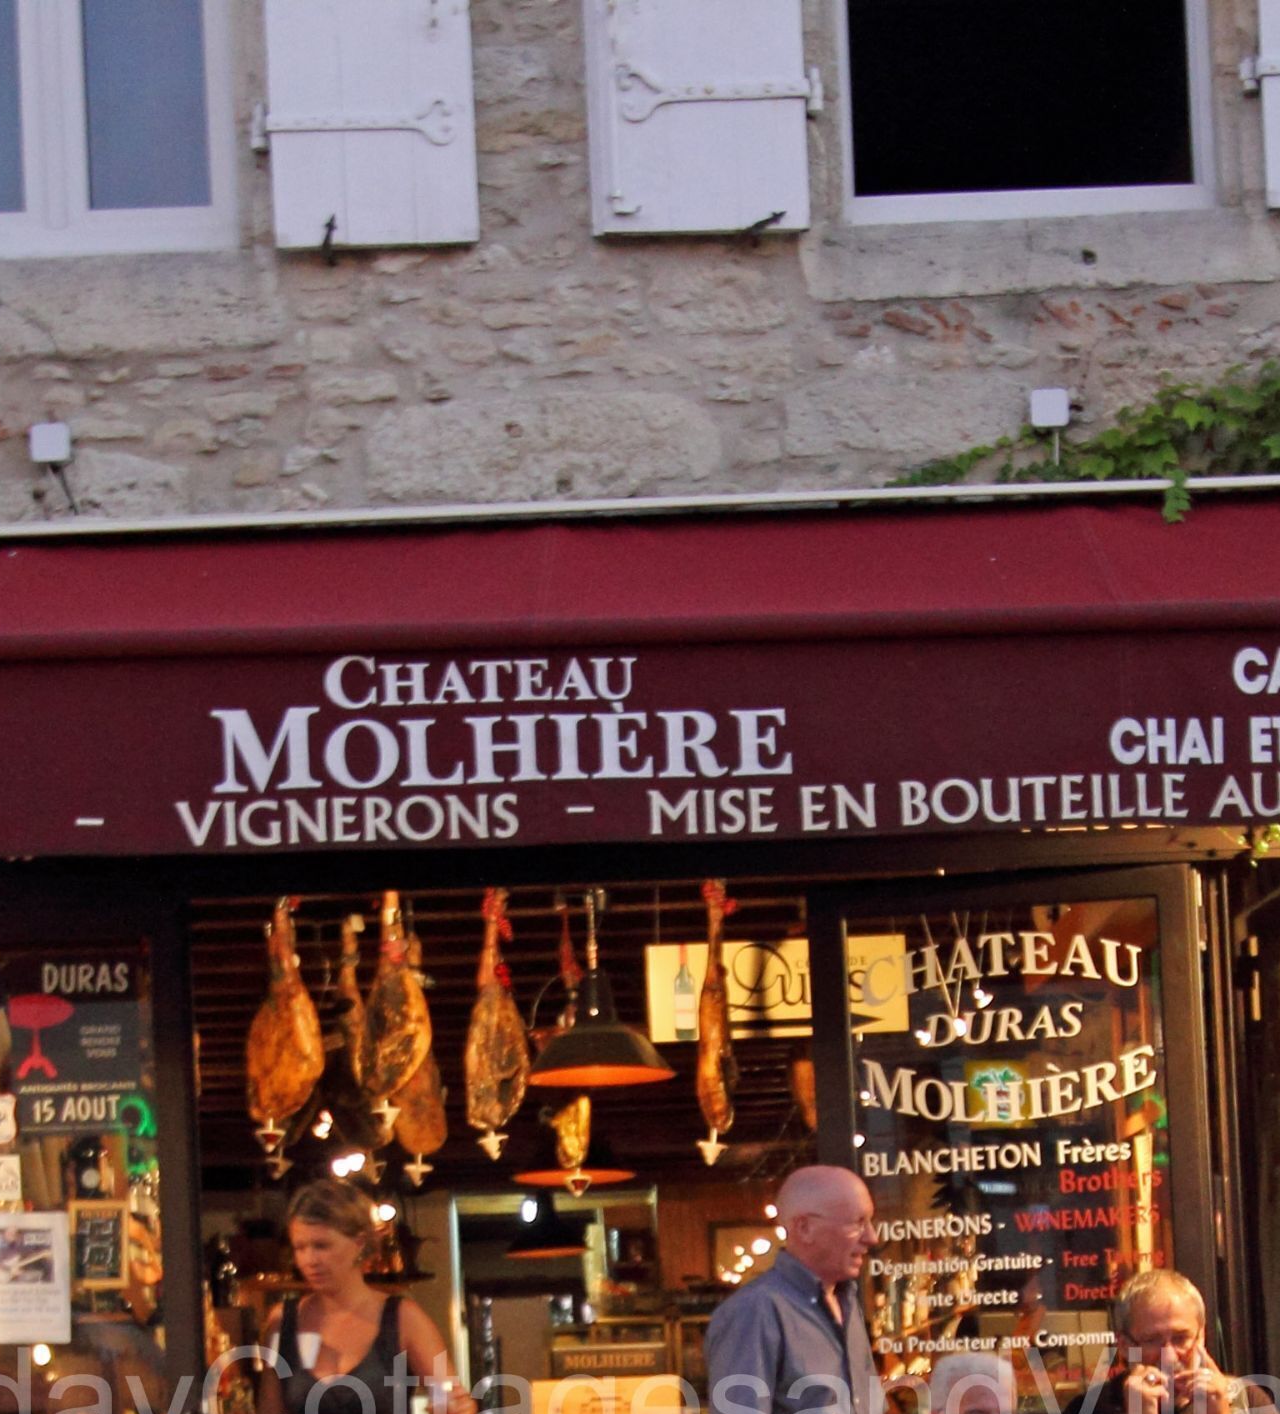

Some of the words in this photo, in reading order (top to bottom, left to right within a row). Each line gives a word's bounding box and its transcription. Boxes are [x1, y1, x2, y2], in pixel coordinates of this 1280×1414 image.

[324, 655, 637, 709] CHATEAU
[210, 704, 793, 793] MOLHIÈRE
[1109, 717, 1225, 766] CHAI
[175, 793, 519, 847] VIGNERONS
[649, 787, 776, 836] MISE
[801, 782, 875, 832] EN
[900, 773, 1189, 827] BOUTEILLE
[42, 962, 129, 993] DURAS
[862, 930, 1142, 1006] CHATEAU
[924, 1002, 1083, 1048] DURAS
[863, 1045, 1157, 1123] MOLHIÈRE
[32, 1098, 56, 1123] 15
[61, 1095, 120, 1122] AOUT
[863, 1141, 1041, 1177] BLANCHETON
[1057, 1137, 1131, 1165] Frères
[870, 1213, 993, 1243] VIGNERONS
[870, 1256, 968, 1278] Dégutation
[975, 1252, 1042, 1274] Gratuite
[1063, 1251, 1098, 1269] Free
[959, 1288, 1019, 1307] Directe
[878, 1336, 904, 1354] Du
[907, 1333, 997, 1354] Producteur
[1002, 1334, 1030, 1349] aux
[1034, 1329, 1117, 1349] Consomm
